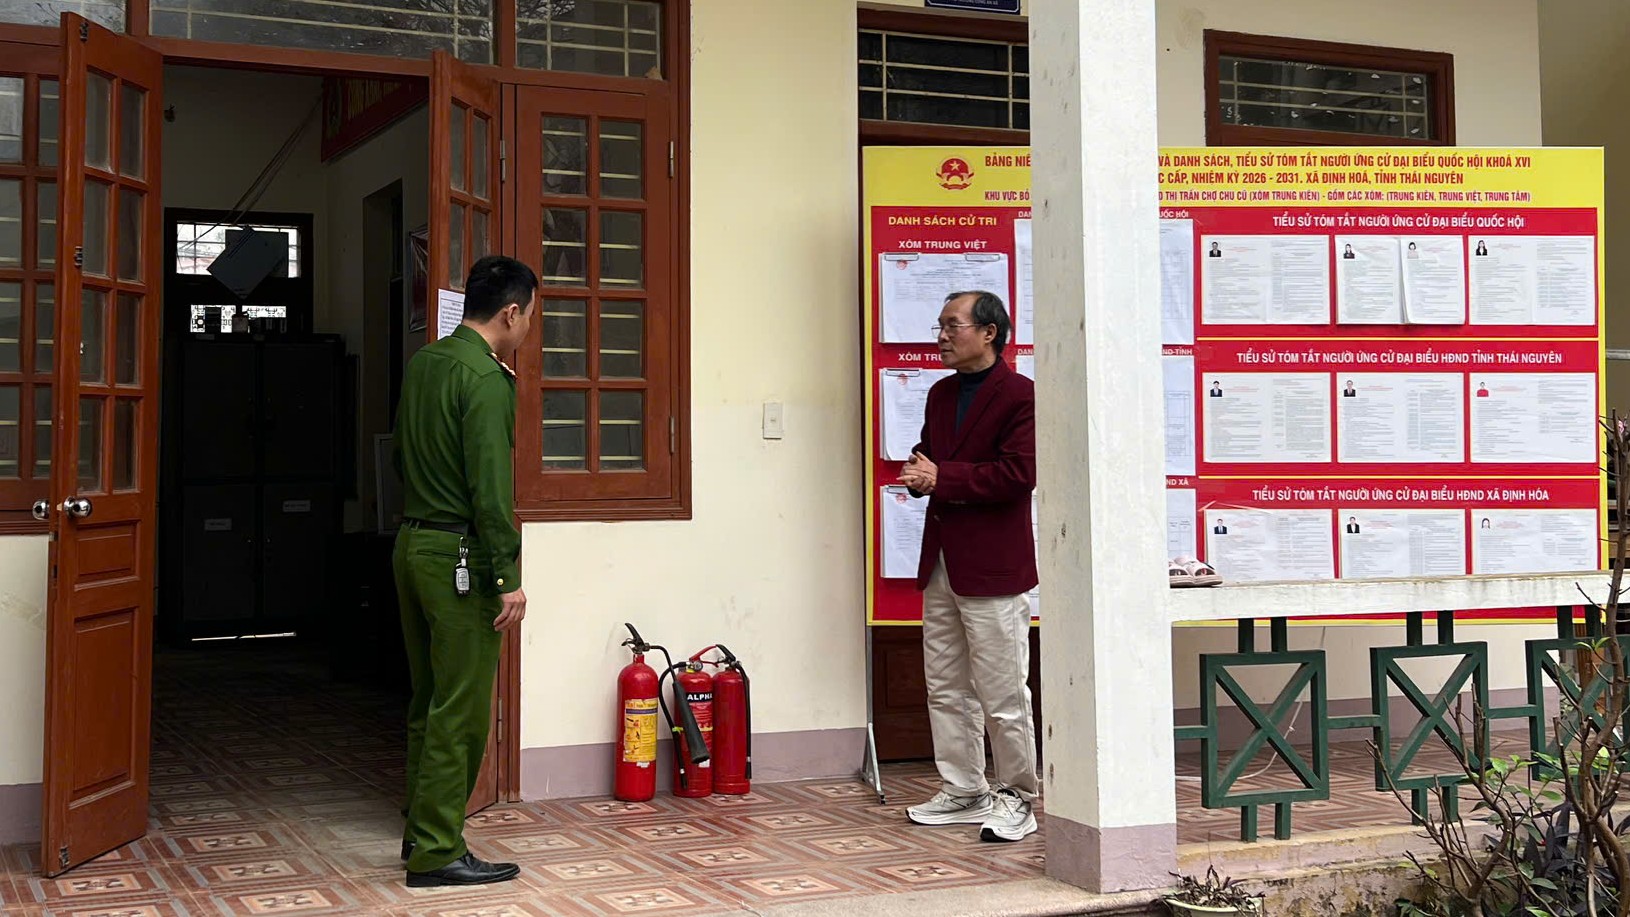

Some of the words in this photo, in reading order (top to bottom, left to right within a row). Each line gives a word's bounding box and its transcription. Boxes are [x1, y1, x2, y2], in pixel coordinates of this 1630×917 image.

[985, 152, 1012, 166] BẢNG
[1174, 155, 1200, 167] DANH
[1204, 153, 1233, 168] SÁCH,
[1236, 151, 1257, 167] TIỂU
[1260, 152, 1274, 167] SỬ
[1276, 153, 1297, 167] TÓM
[1320, 153, 1351, 167] NGƯỜI
[1354, 152, 1374, 167] ỨNG
[1377, 152, 1391, 167] CỬ
[1393, 156, 1409, 170] ĐẠI
[1413, 152, 1435, 167] BIỂU
[1438, 152, 1464, 168] QUỐC
[1467, 154, 1483, 170] HỘI
[1486, 154, 1512, 167] KHOÁ
[1515, 156, 1531, 168] XVI
[1168, 169, 1188, 184] CẤP,
[1192, 170, 1224, 186] NHIỆM
[1227, 170, 1240, 184] KỲ
[1242, 172, 1266, 184] 2026
[1277, 172, 1303, 184] 2031.
[1306, 170, 1319, 184] XÃ
[1322, 173, 1345, 185] ĐỊNH
[1349, 170, 1371, 184] HOÁ,
[1375, 169, 1396, 184] TỈNH
[1400, 170, 1421, 184] THÁI
[1424, 170, 1463, 184] NGUYÊN
[985, 191, 1000, 200] KHU
[1002, 190, 1017, 202] VỰC
[1166, 191, 1177, 202] THỊ
[1180, 189, 1199, 200] TRẤN
[1202, 191, 1217, 202] CHỢ
[1219, 191, 1235, 200] CHU
[1237, 189, 1246, 200] CŨ
[1250, 189, 1269, 201] (XÓM
[1272, 191, 1297, 200] TRUNG
[1299, 189, 1320, 201] KIÊN)
[1328, 189, 1344, 200] GỒM
[1347, 190, 1362, 200] CÁC
[1365, 190, 1384, 201] XÓM:
[1387, 191, 1414, 201] (TRUNG
[1417, 190, 1436, 202] KIÊN,
[1439, 191, 1463, 201] TRUNG
[1485, 191, 1509, 201] TRUNG
[1512, 190, 1530, 202] TÂM)
[888, 217, 920, 226] DANH
[924, 215, 955, 226] SÁCH
[959, 214, 976, 226] CỬ
[978, 217, 996, 225] TRI
[1273, 211, 1295, 227] TIỂU
[1298, 212, 1312, 227] SỬ
[1314, 214, 1335, 227] TÓM
[1359, 214, 1390, 227] NGƯỜI
[1392, 213, 1413, 227] ỨNG
[1416, 212, 1430, 227] CỬ
[1433, 216, 1448, 230] ĐẠI
[1452, 212, 1474, 228] BIỂU
[1476, 213, 1505, 228] QUỐC
[1508, 215, 1524, 230] HỘI
[899, 239, 921, 249] XÓM
[964, 239, 987, 250] VIỆT
[899, 352, 921, 361] XÓM
[1237, 348, 1259, 363] TIỂU
[1262, 349, 1275, 363] SỬ
[1278, 350, 1298, 363] TÓM
[1323, 350, 1354, 363] NGƯỜI
[1356, 350, 1377, 363] ỨNG
[1380, 349, 1395, 363] CỬ
[1397, 353, 1413, 365] ĐẠI
[1416, 348, 1438, 363] BIỂU
[1442, 353, 1468, 363] HĐND
[1471, 350, 1494, 363] TỈNH
[1497, 351, 1518, 363] THÁI
[1522, 351, 1562, 363] NGUYÊN
[1253, 485, 1275, 500] TIỂU
[1277, 486, 1291, 500] SỬ
[1294, 488, 1314, 500] TÓM
[1338, 488, 1369, 500] NGƯỜI
[1372, 487, 1393, 500] ỨNG
[1396, 486, 1410, 500] CỬ
[1412, 490, 1428, 502] ĐẠI
[1431, 485, 1454, 500] BIỂU
[1457, 490, 1484, 500] HĐND
[1487, 488, 1500, 500] XÃ
[1502, 490, 1526, 502] ĐỊNH
[1529, 488, 1549, 500] HÓA
